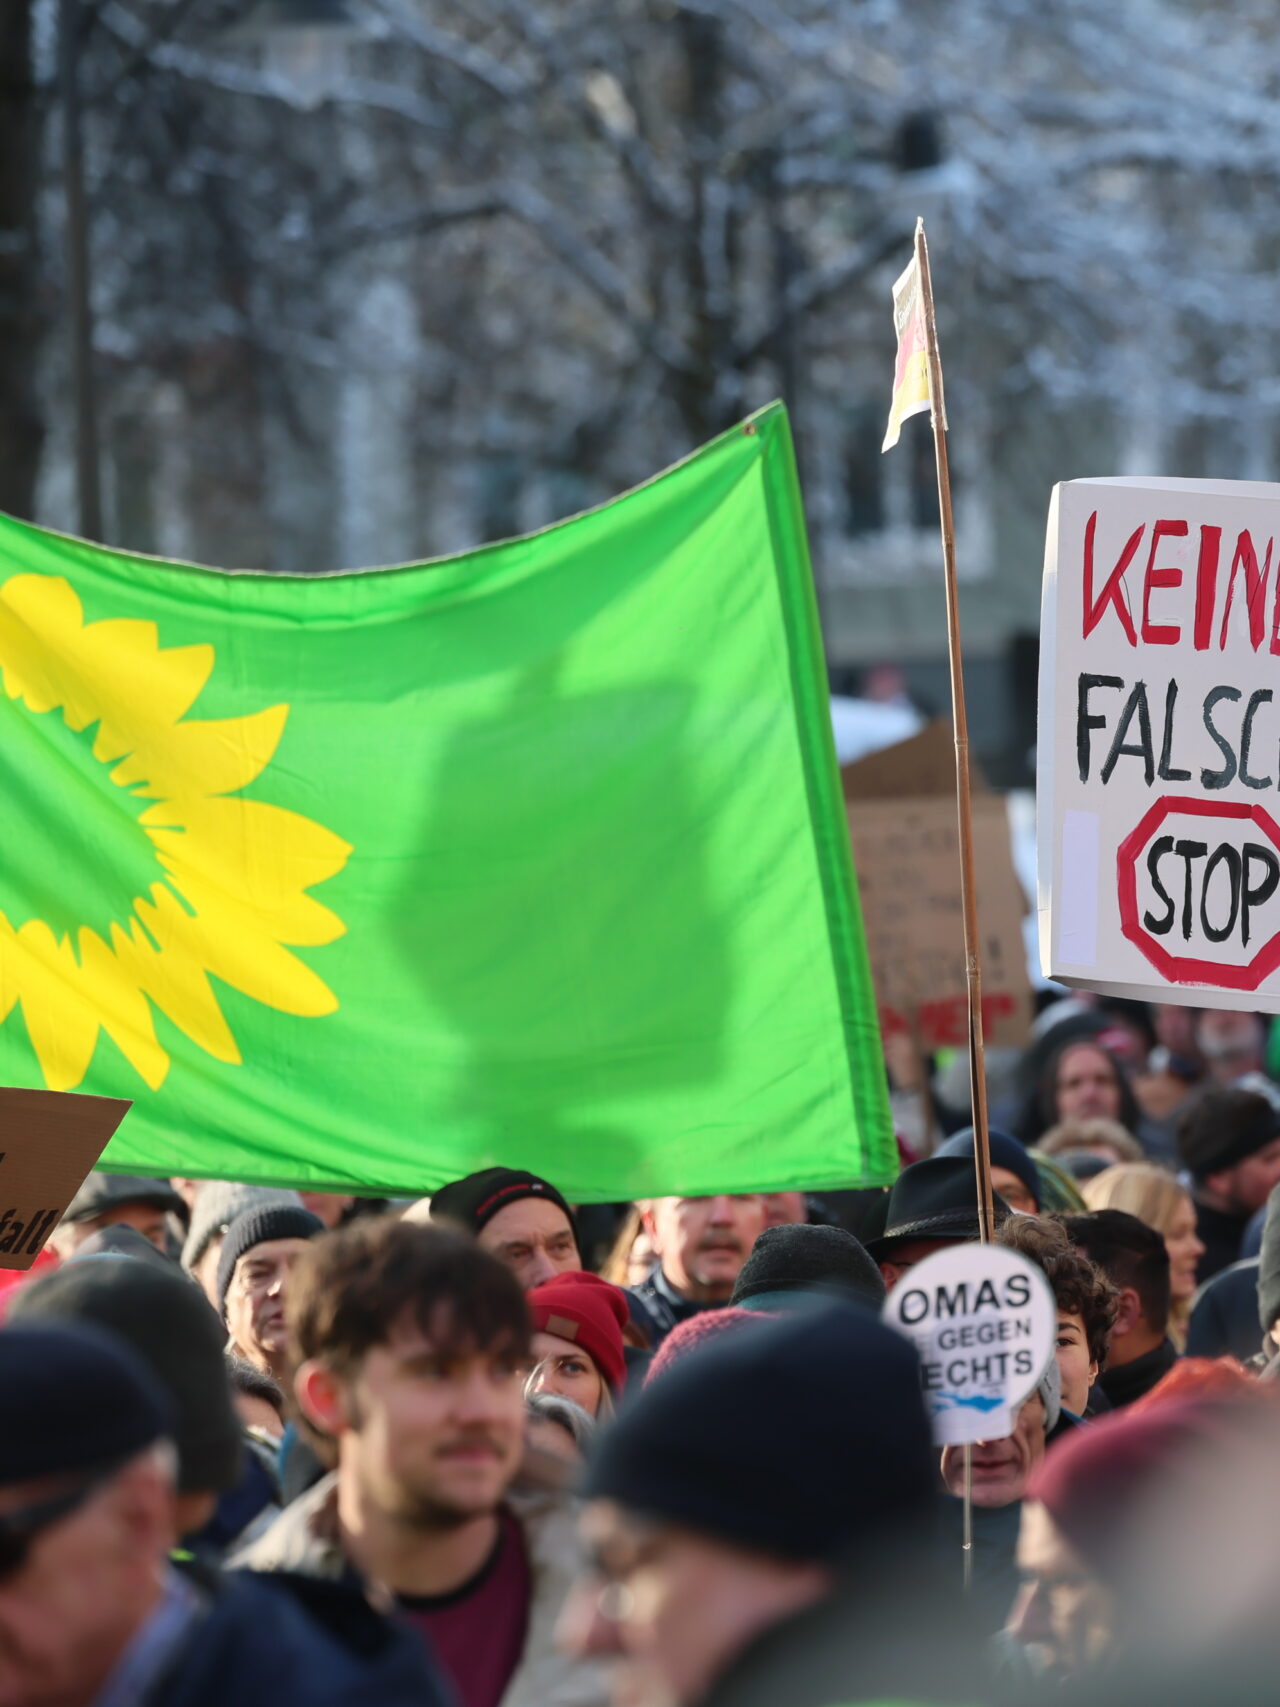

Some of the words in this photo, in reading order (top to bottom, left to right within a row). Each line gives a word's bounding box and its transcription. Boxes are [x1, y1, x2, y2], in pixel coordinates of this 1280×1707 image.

[1143, 835, 1280, 948] STOP
[900, 1274, 1031, 1325] OMAS
[938, 1318, 1031, 1351] GEGEN
[921, 1350, 1033, 1390] ECHTS
